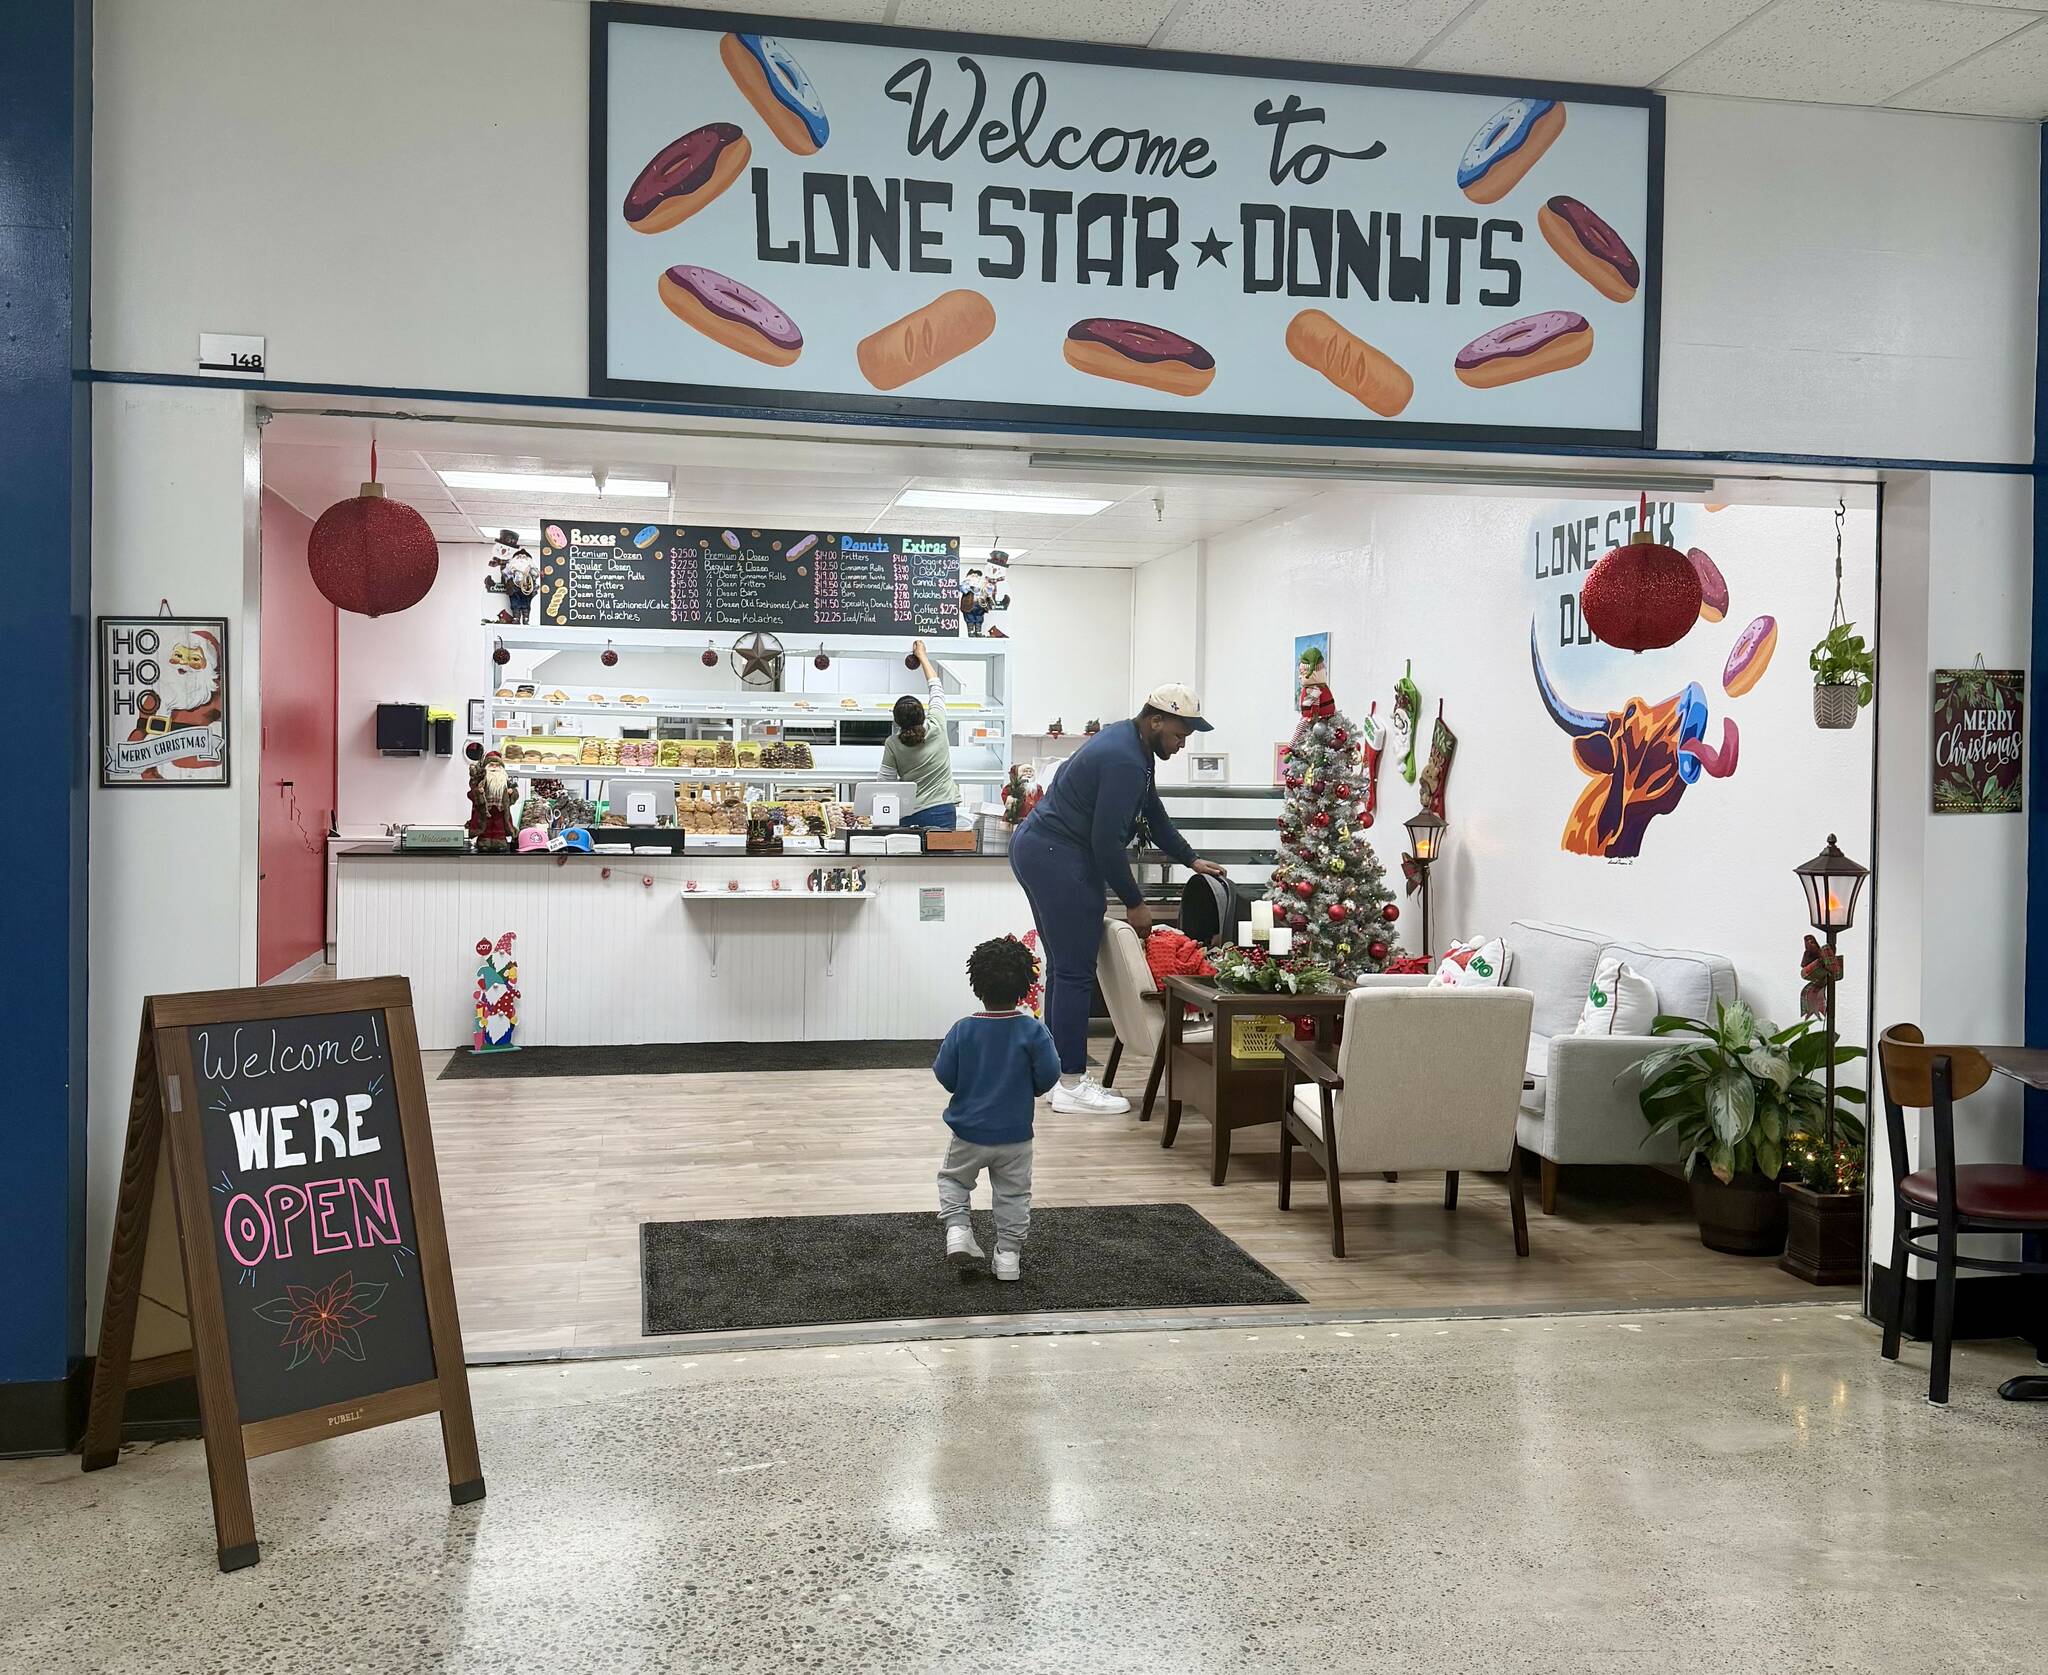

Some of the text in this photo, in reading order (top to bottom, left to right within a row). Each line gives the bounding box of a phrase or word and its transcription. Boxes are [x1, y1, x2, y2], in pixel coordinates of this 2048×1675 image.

[885, 56, 1388, 187] Welcome to
[751, 166, 1524, 307] LONE STAR DONUTS
[230, 353, 262, 369] 148
[571, 529, 616, 545] Boxes
[841, 536, 889, 551] Donuts
[902, 538, 947, 554] Extras
[1535, 516, 1599, 579] LONE
[570, 546, 608, 558] Premium
[614, 548, 642, 560] Dozen
[704, 549, 736, 560] Premium
[747, 550, 769, 561] Dozen
[841, 552, 869, 561] Fritters
[570, 559, 602, 574] Regular
[608, 559, 631, 571] Dozen
[704, 560, 733, 574] Regular
[746, 562, 768, 572] Dozen
[870, 564, 884, 572] Rolls
[918, 566, 945, 576] Donuts
[570, 571, 592, 580] Dozen
[594, 571, 625, 580] Cinnamon
[628, 571, 645, 580] Rolls
[719, 571, 738, 579] Dozen
[739, 572, 767, 580] Cinnamon
[769, 572, 786, 580] Rolls
[569, 580, 592, 589] Dozen
[595, 581, 624, 590] Fritters
[717, 579, 737, 587] Dozen
[840, 581, 851, 589] Old
[569, 589, 593, 598] Dozen
[596, 590, 615, 598] Bars
[717, 588, 737, 596] Dozen
[740, 588, 757, 596] Bars
[842, 589, 855, 597] Bars
[569, 599, 594, 608] Dozen
[596, 600, 609, 609] Old
[717, 599, 739, 608] Dozen
[741, 599, 754, 608] Old
[871, 599, 892, 608] Donuts
[913, 604, 938, 615] Coffee
[569, 609, 596, 620] Dozen
[600, 610, 640, 621] Kolaches
[717, 611, 740, 624] Dozen
[742, 613, 783, 624] Kolaches
[915, 615, 940, 625] Donut
[113, 628, 160, 654] HO
[113, 659, 161, 685] HO
[113, 689, 161, 715] HO
[1963, 709, 2016, 731] MERRY
[121, 736, 206, 762] MERRY CHRISTMAS
[1936, 723, 2023, 773] Christmas
[198, 1015, 383, 1082] Welcome!
[228, 1093, 381, 1172] WE'RE
[223, 1177, 401, 1267] OPEN
